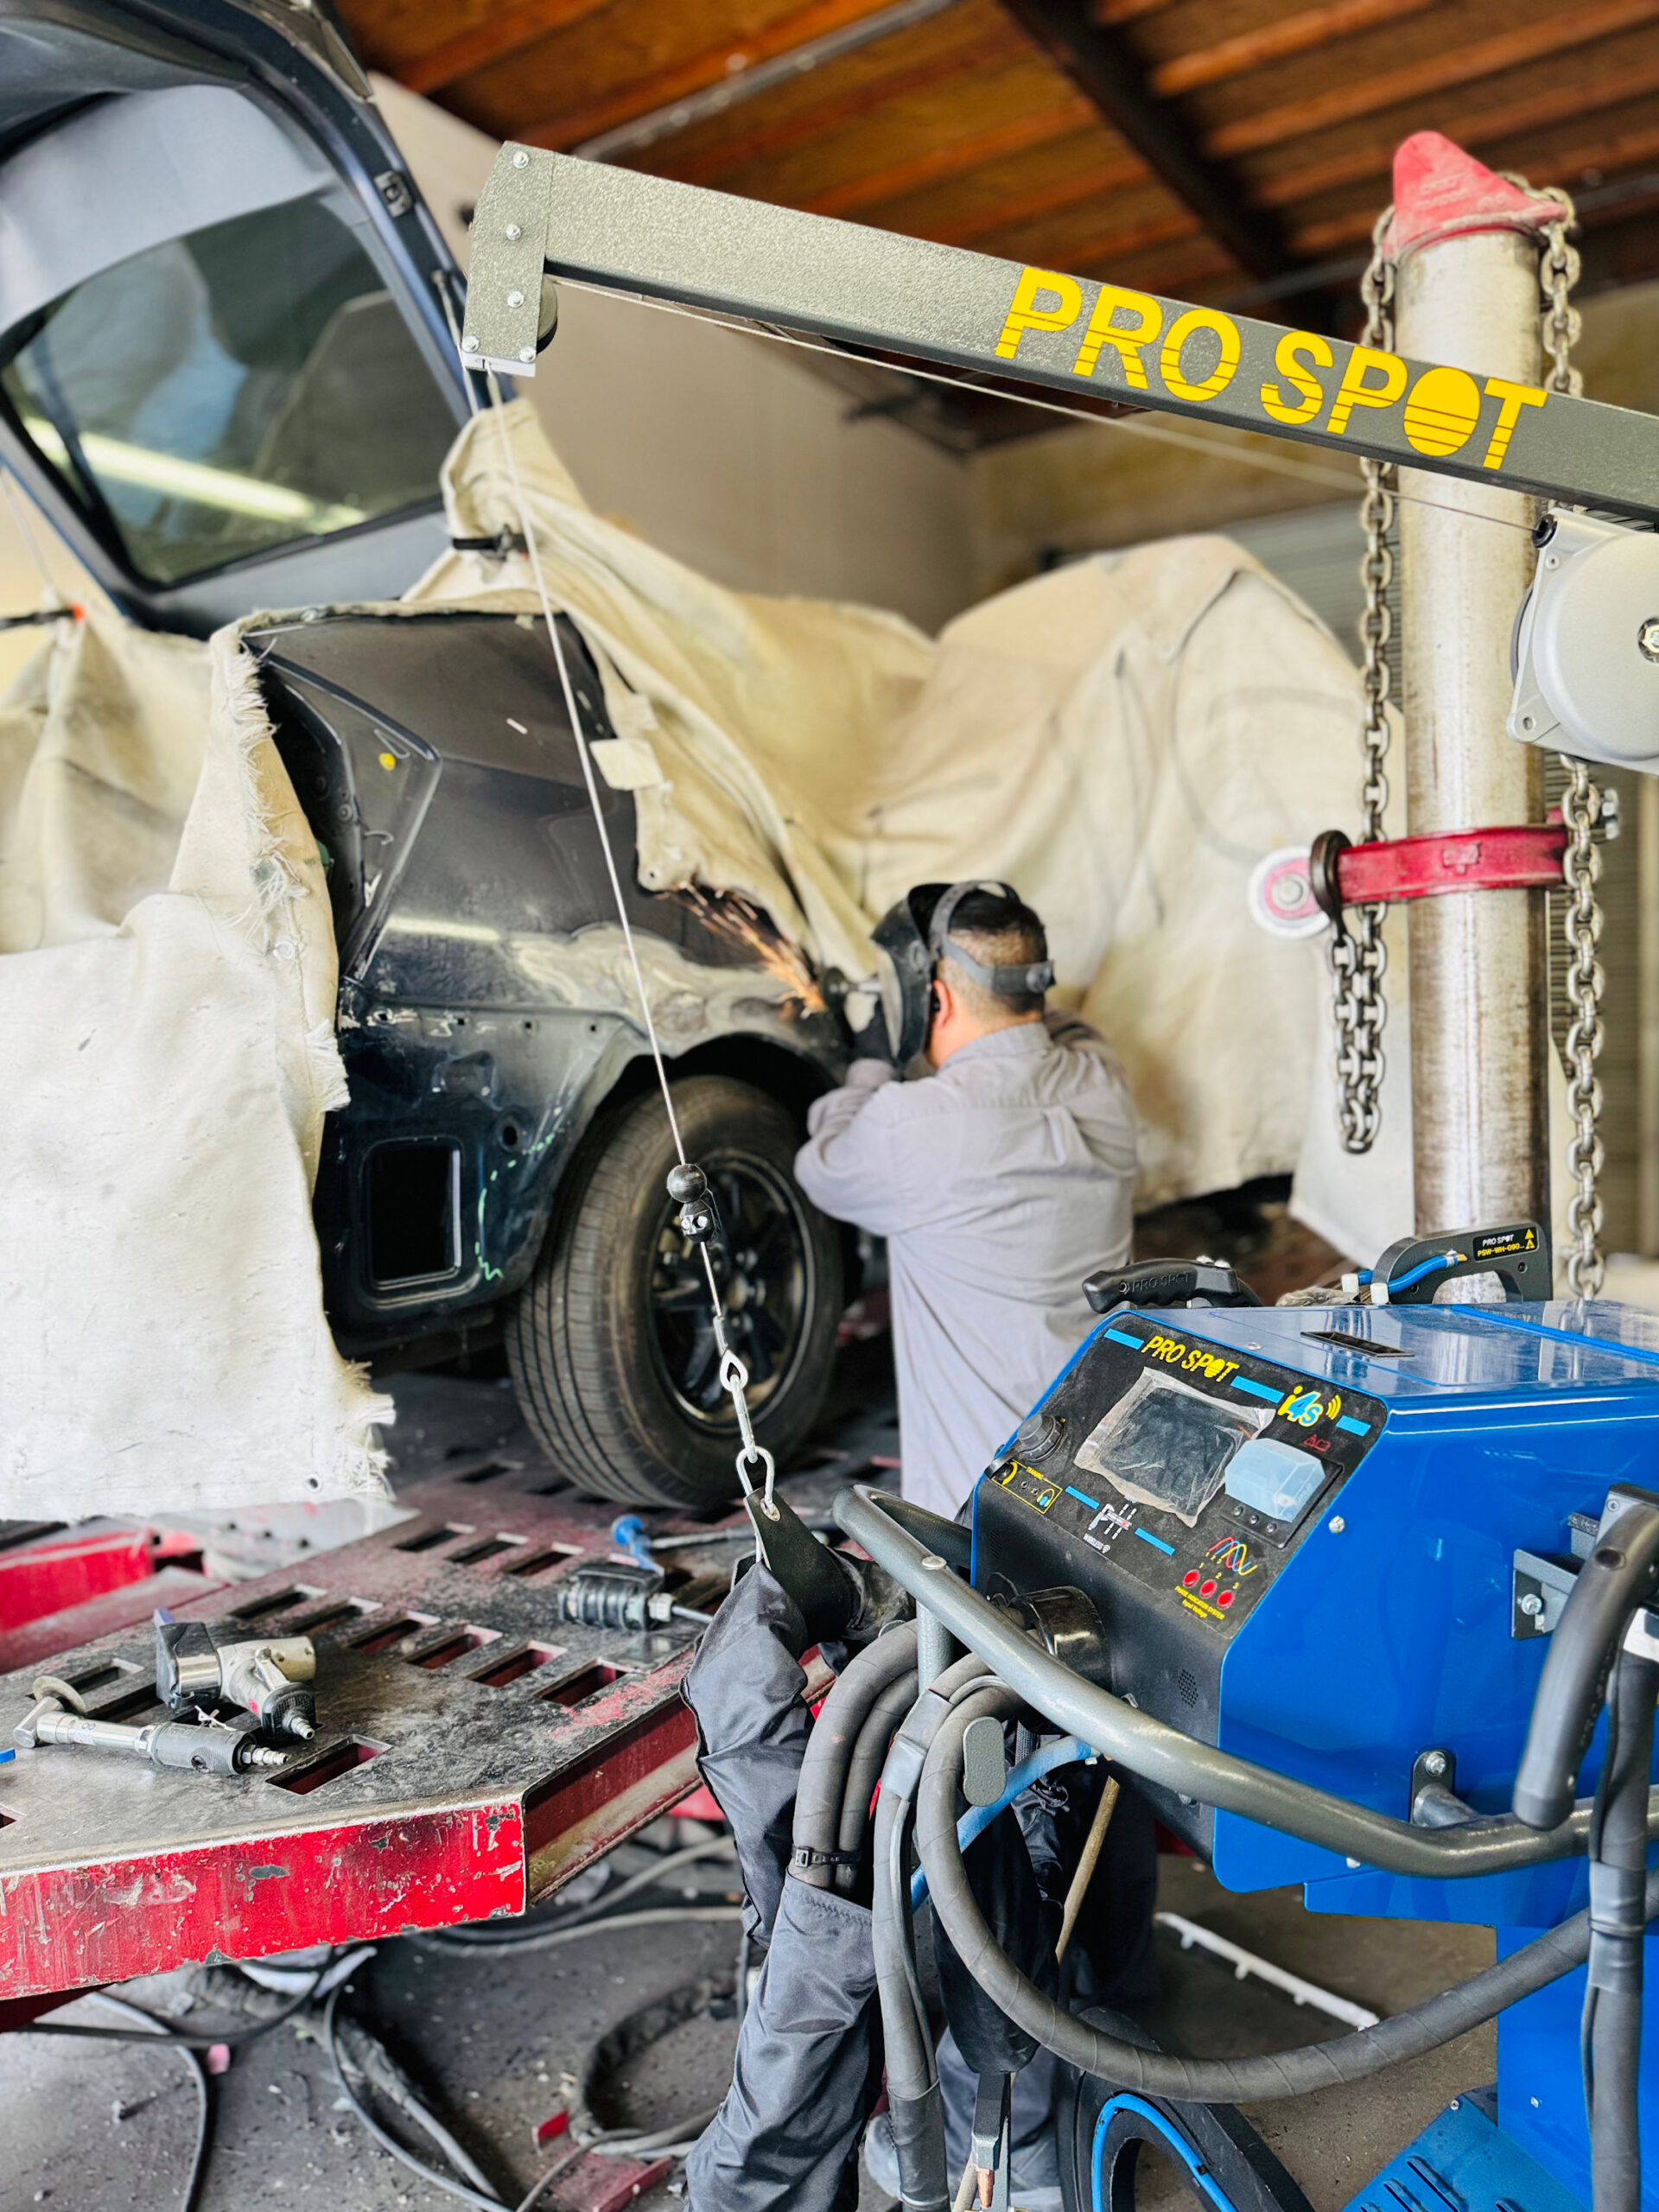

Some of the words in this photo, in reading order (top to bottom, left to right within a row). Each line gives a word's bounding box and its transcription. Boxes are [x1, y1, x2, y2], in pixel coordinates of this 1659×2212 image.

[995, 267, 1241, 401] PRO
[1261, 331, 1548, 470] SPOT
[1483, 1238, 1497, 1247] PRO
[1497, 1234, 1514, 1243] SPOT
[1132, 1277, 1157, 1293] PRO
[1141, 1335, 1186, 1363] PRO
[1180, 1350, 1240, 1382] SPOT
